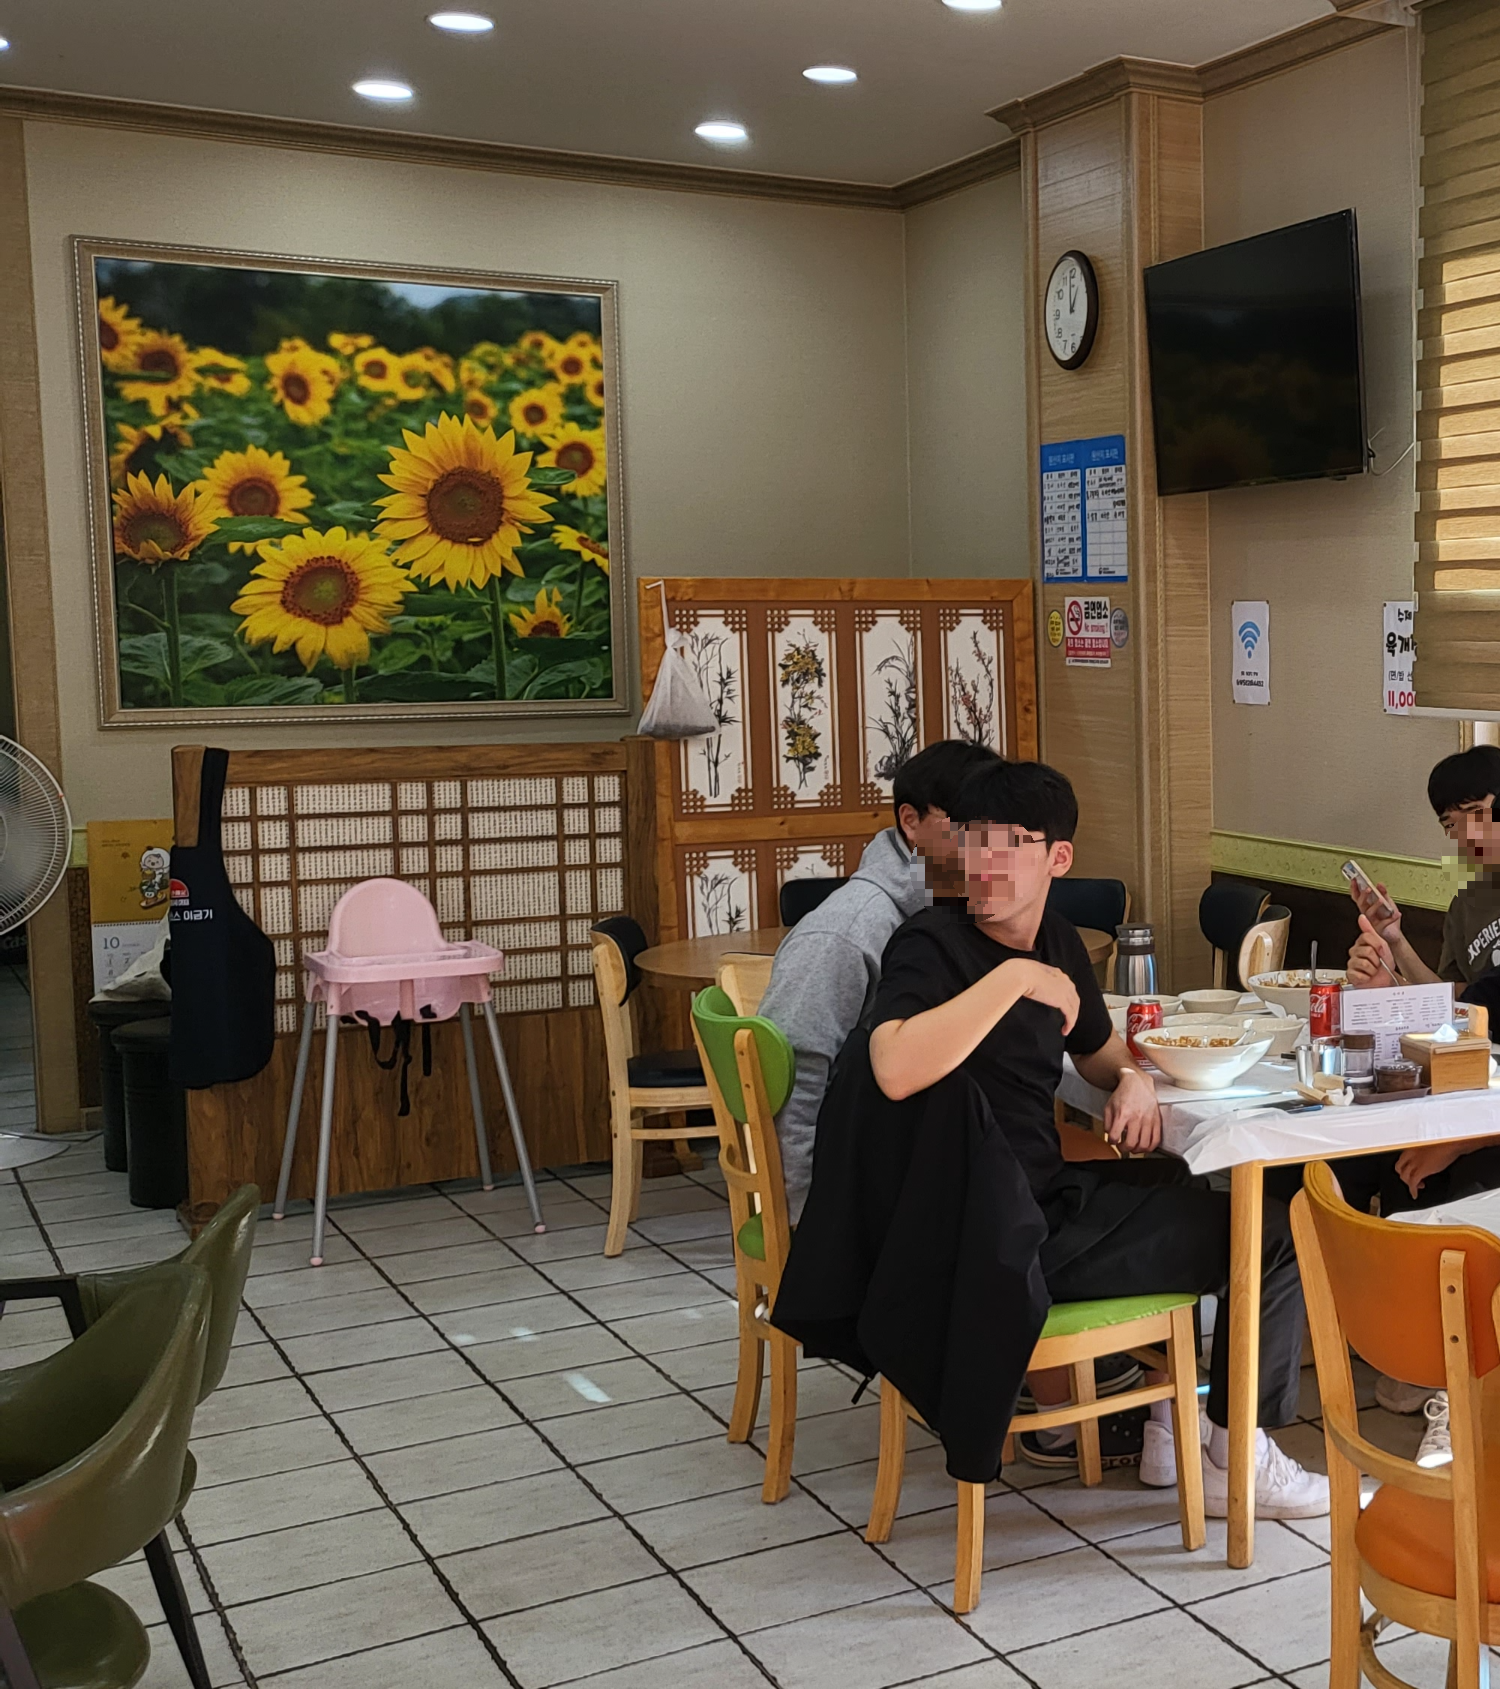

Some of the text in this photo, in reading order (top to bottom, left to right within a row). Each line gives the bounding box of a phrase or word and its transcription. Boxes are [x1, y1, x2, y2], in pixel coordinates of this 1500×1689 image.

[1056, 289, 1064, 301] 10
[1084, 600, 1109, 620] 금연업소
[183, 909, 213, 921] 이금기
[103, 936, 120, 949] 10
